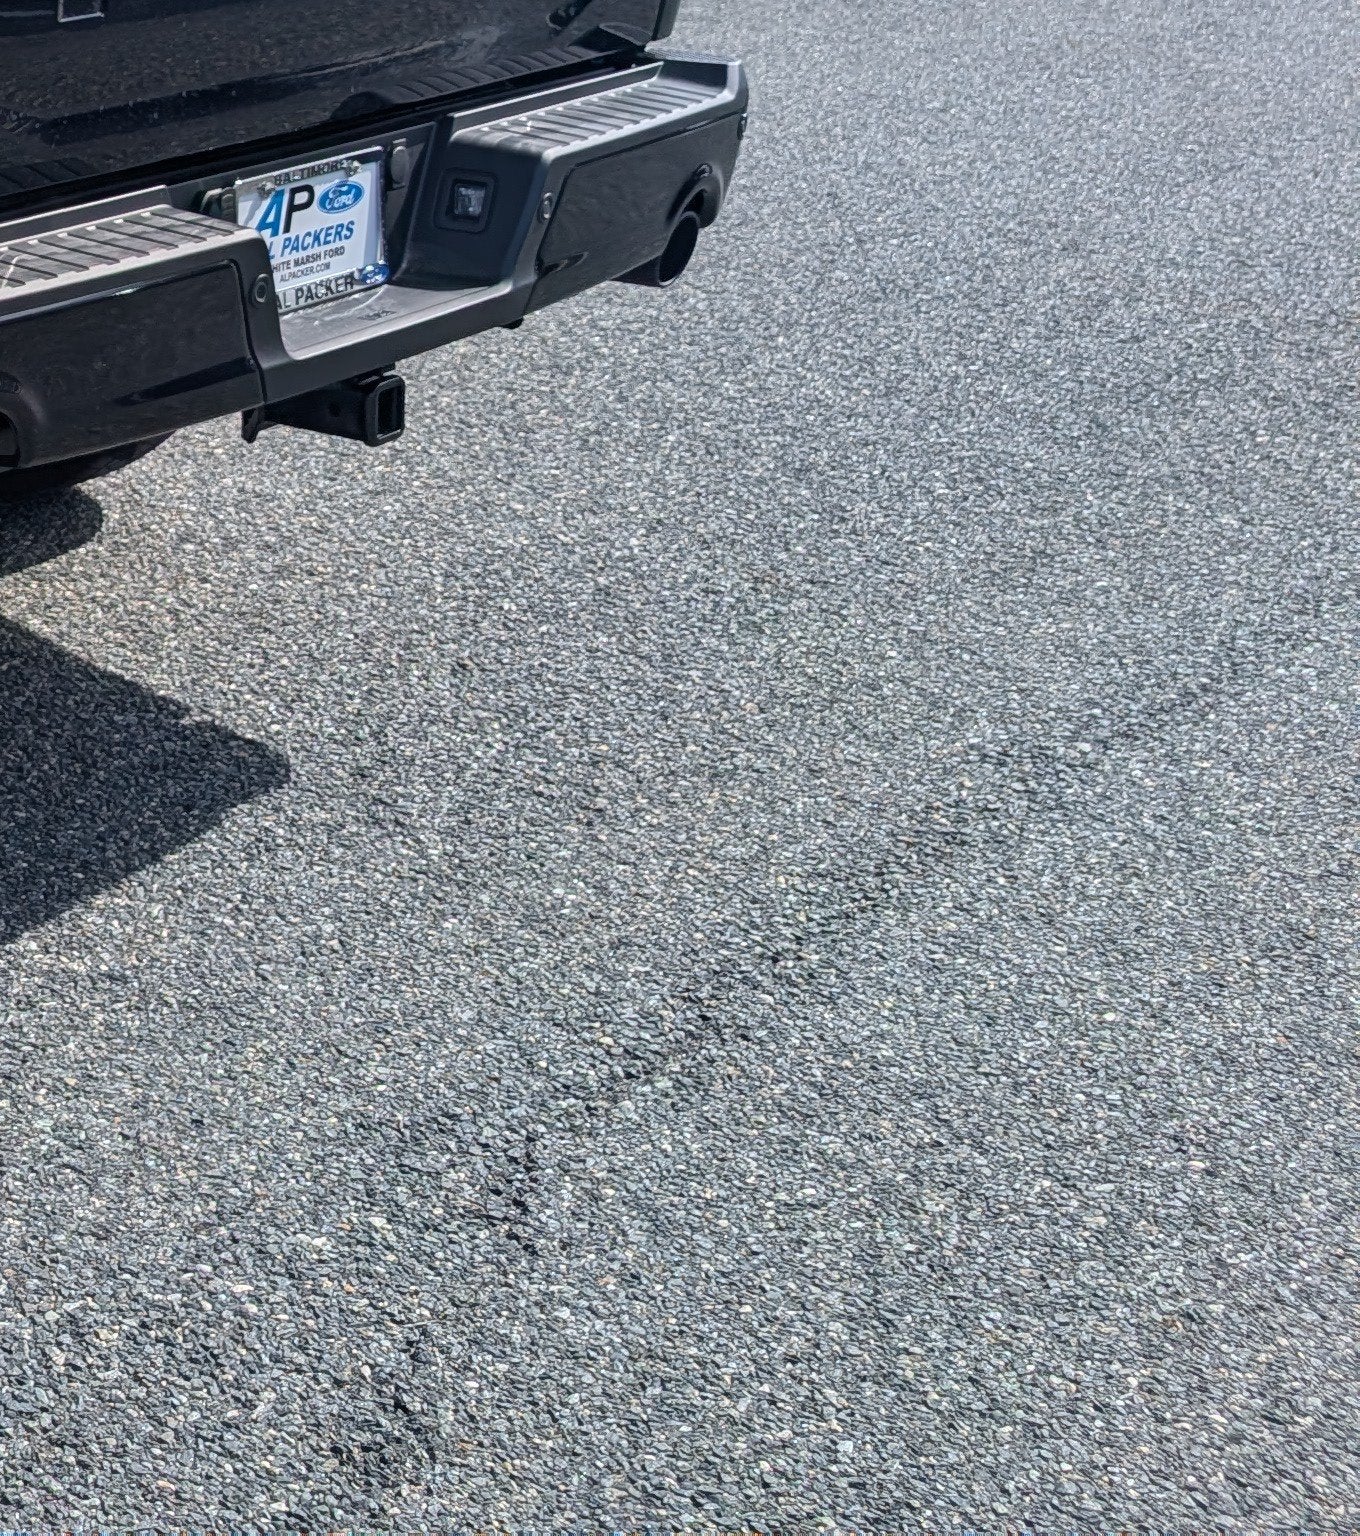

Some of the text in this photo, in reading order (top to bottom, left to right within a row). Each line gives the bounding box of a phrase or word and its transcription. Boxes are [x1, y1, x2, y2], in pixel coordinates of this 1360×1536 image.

[255, 184, 315, 238] AP
[325, 185, 356, 209] Ford
[281, 220, 355, 257] PACKERS
[272, 245, 346, 272] HITE MARSH FORD
[295, 272, 355, 305] PACKER
